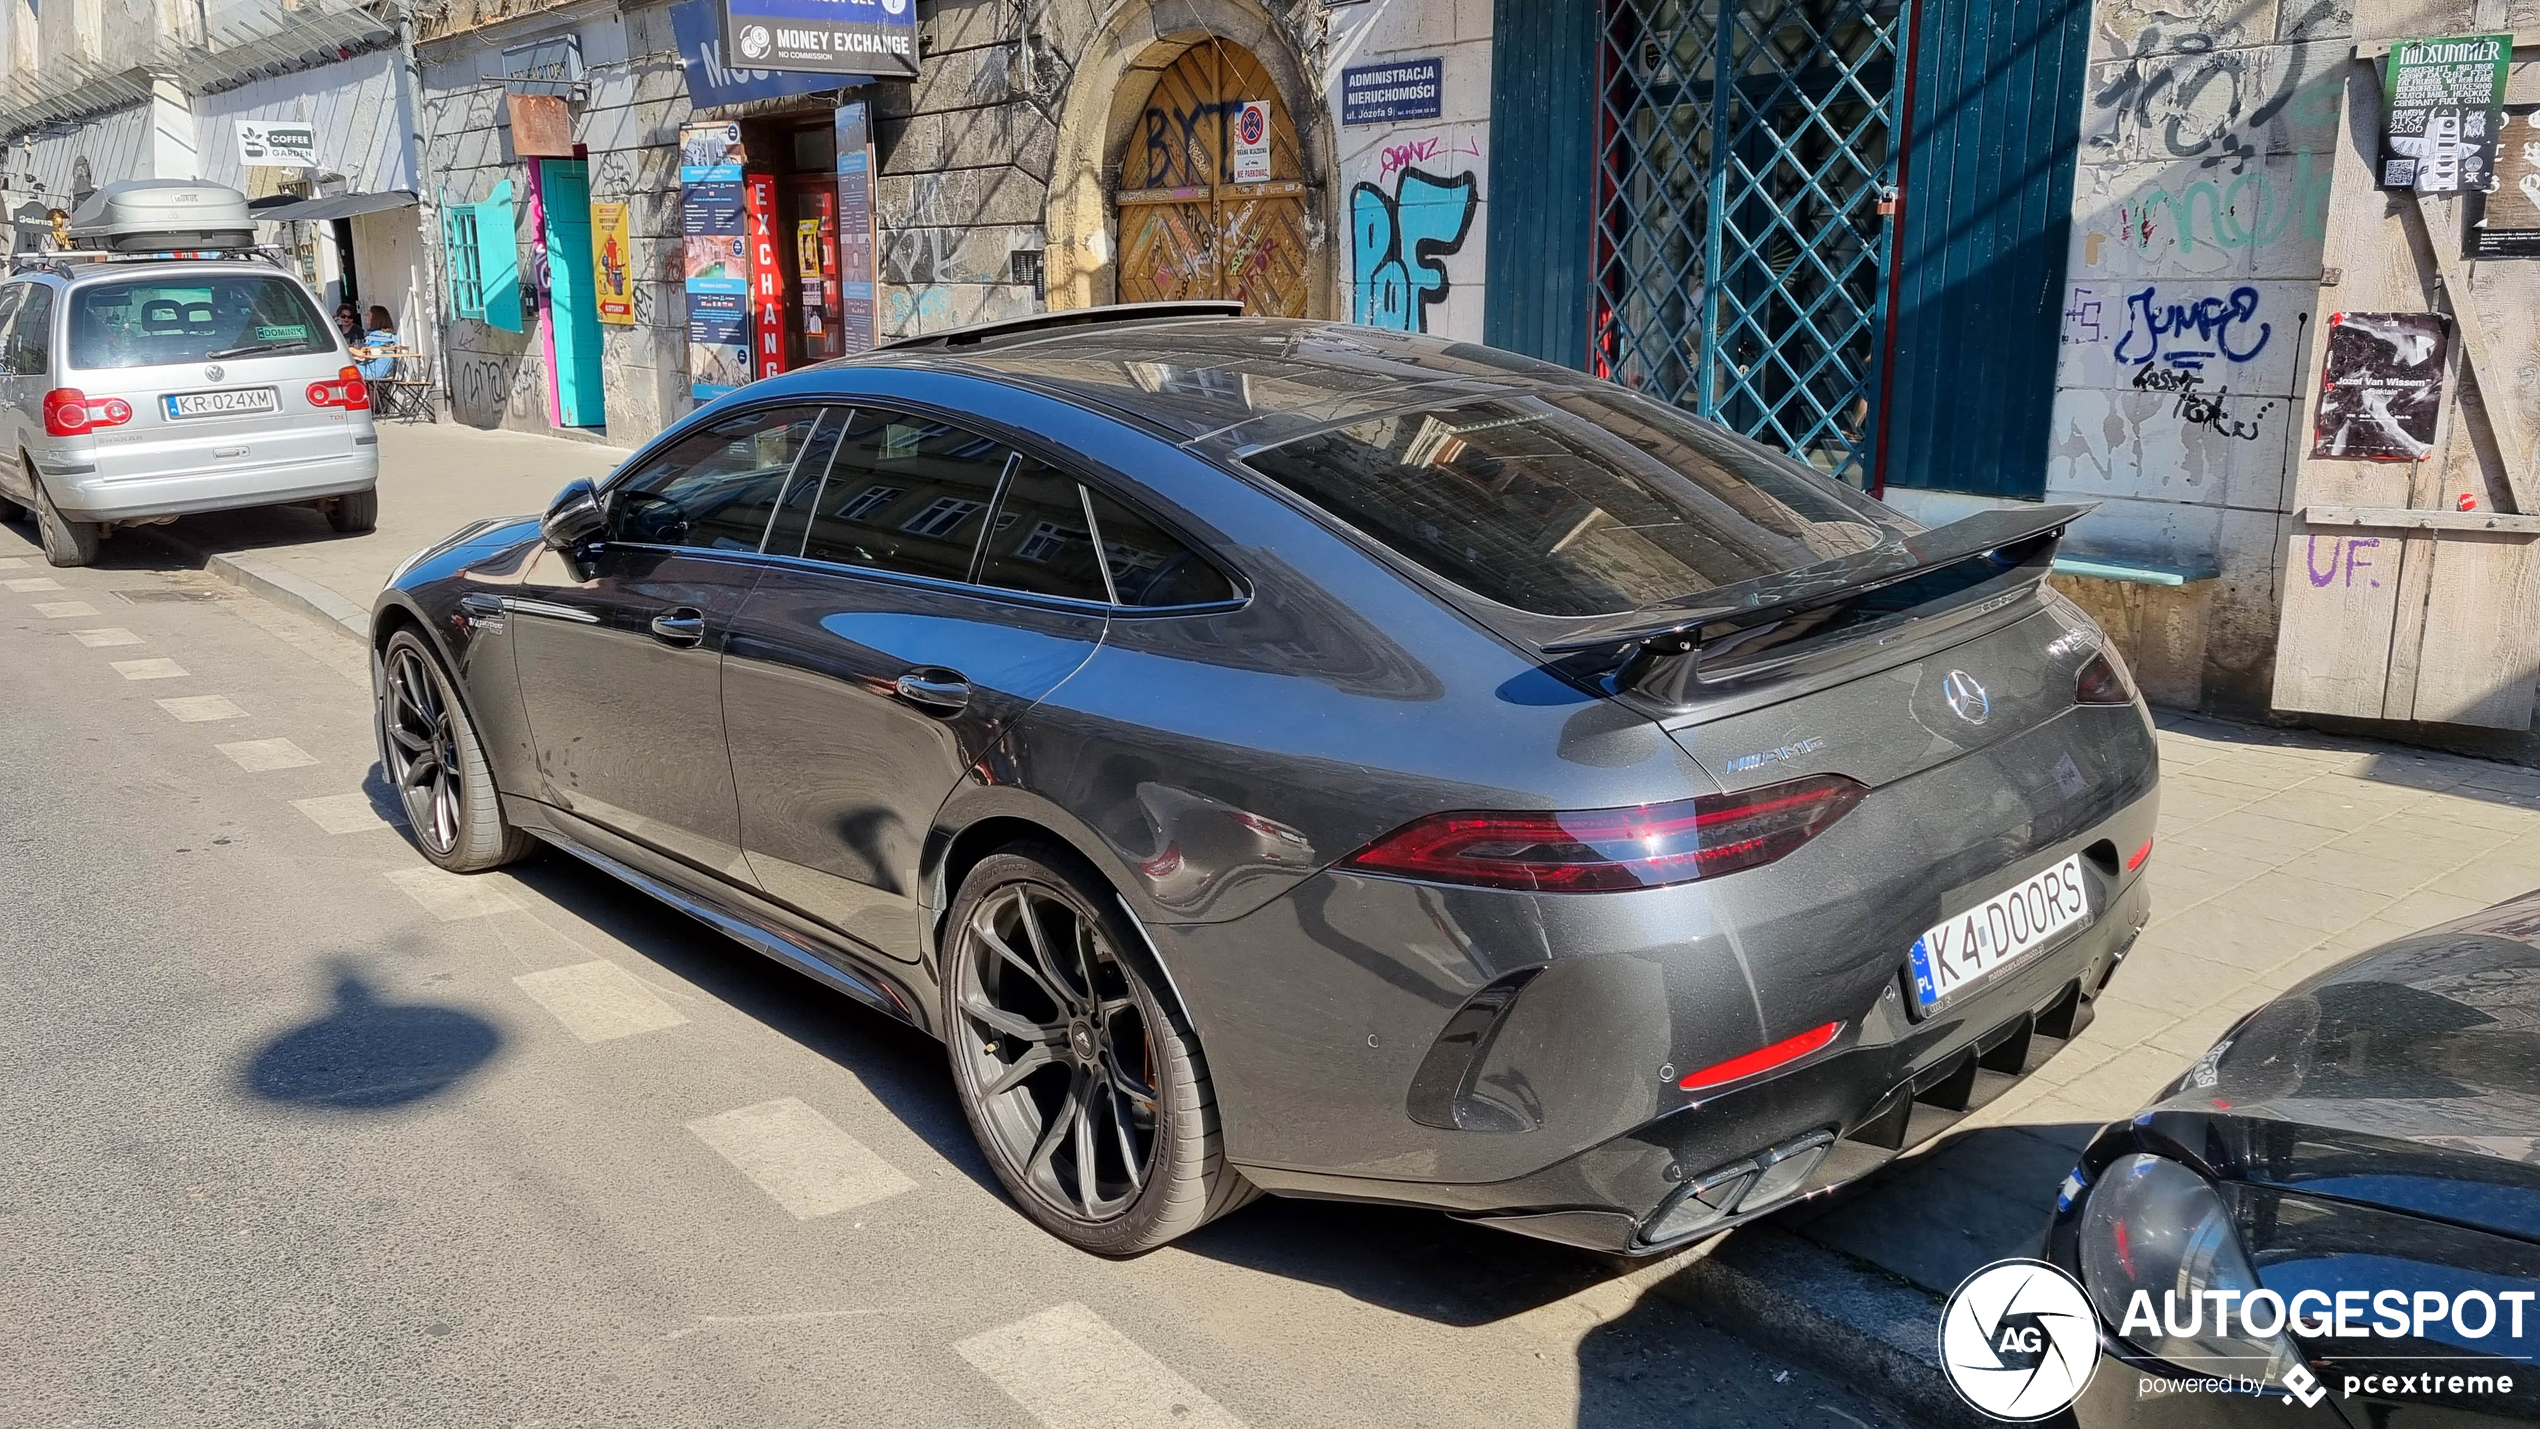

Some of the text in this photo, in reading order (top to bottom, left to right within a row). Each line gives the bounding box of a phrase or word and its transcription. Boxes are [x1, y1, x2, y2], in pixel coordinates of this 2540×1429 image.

[776, 28, 910, 54] MONEY EXCHANGE
[790, 52, 832, 60] COMMISSION
[2399, 41, 2500, 64] MIDSUMMER
[1348, 65, 1435, 88] ADMINISTRACJA
[1347, 82, 1435, 106] NIERUCHOMOŚCI
[2439, 97, 2459, 105] FUCK
[2464, 96, 2491, 104] GINA
[1346, 111, 1357, 120] ul.
[1358, 107, 1386, 119] Józefa
[1387, 107, 1393, 116] 9
[2388, 124, 2424, 134] 25.06
[271, 135, 309, 144] COFFEE
[272, 149, 312, 158] GARDEN
[264, 327, 304, 337] DOMINIK
[2336, 377, 2425, 386] Jozef Van Wissem
[179, 396, 207, 412] KR
[212, 391, 269, 410] 024XM
[1917, 862, 2081, 994] PL K4 DOORS
